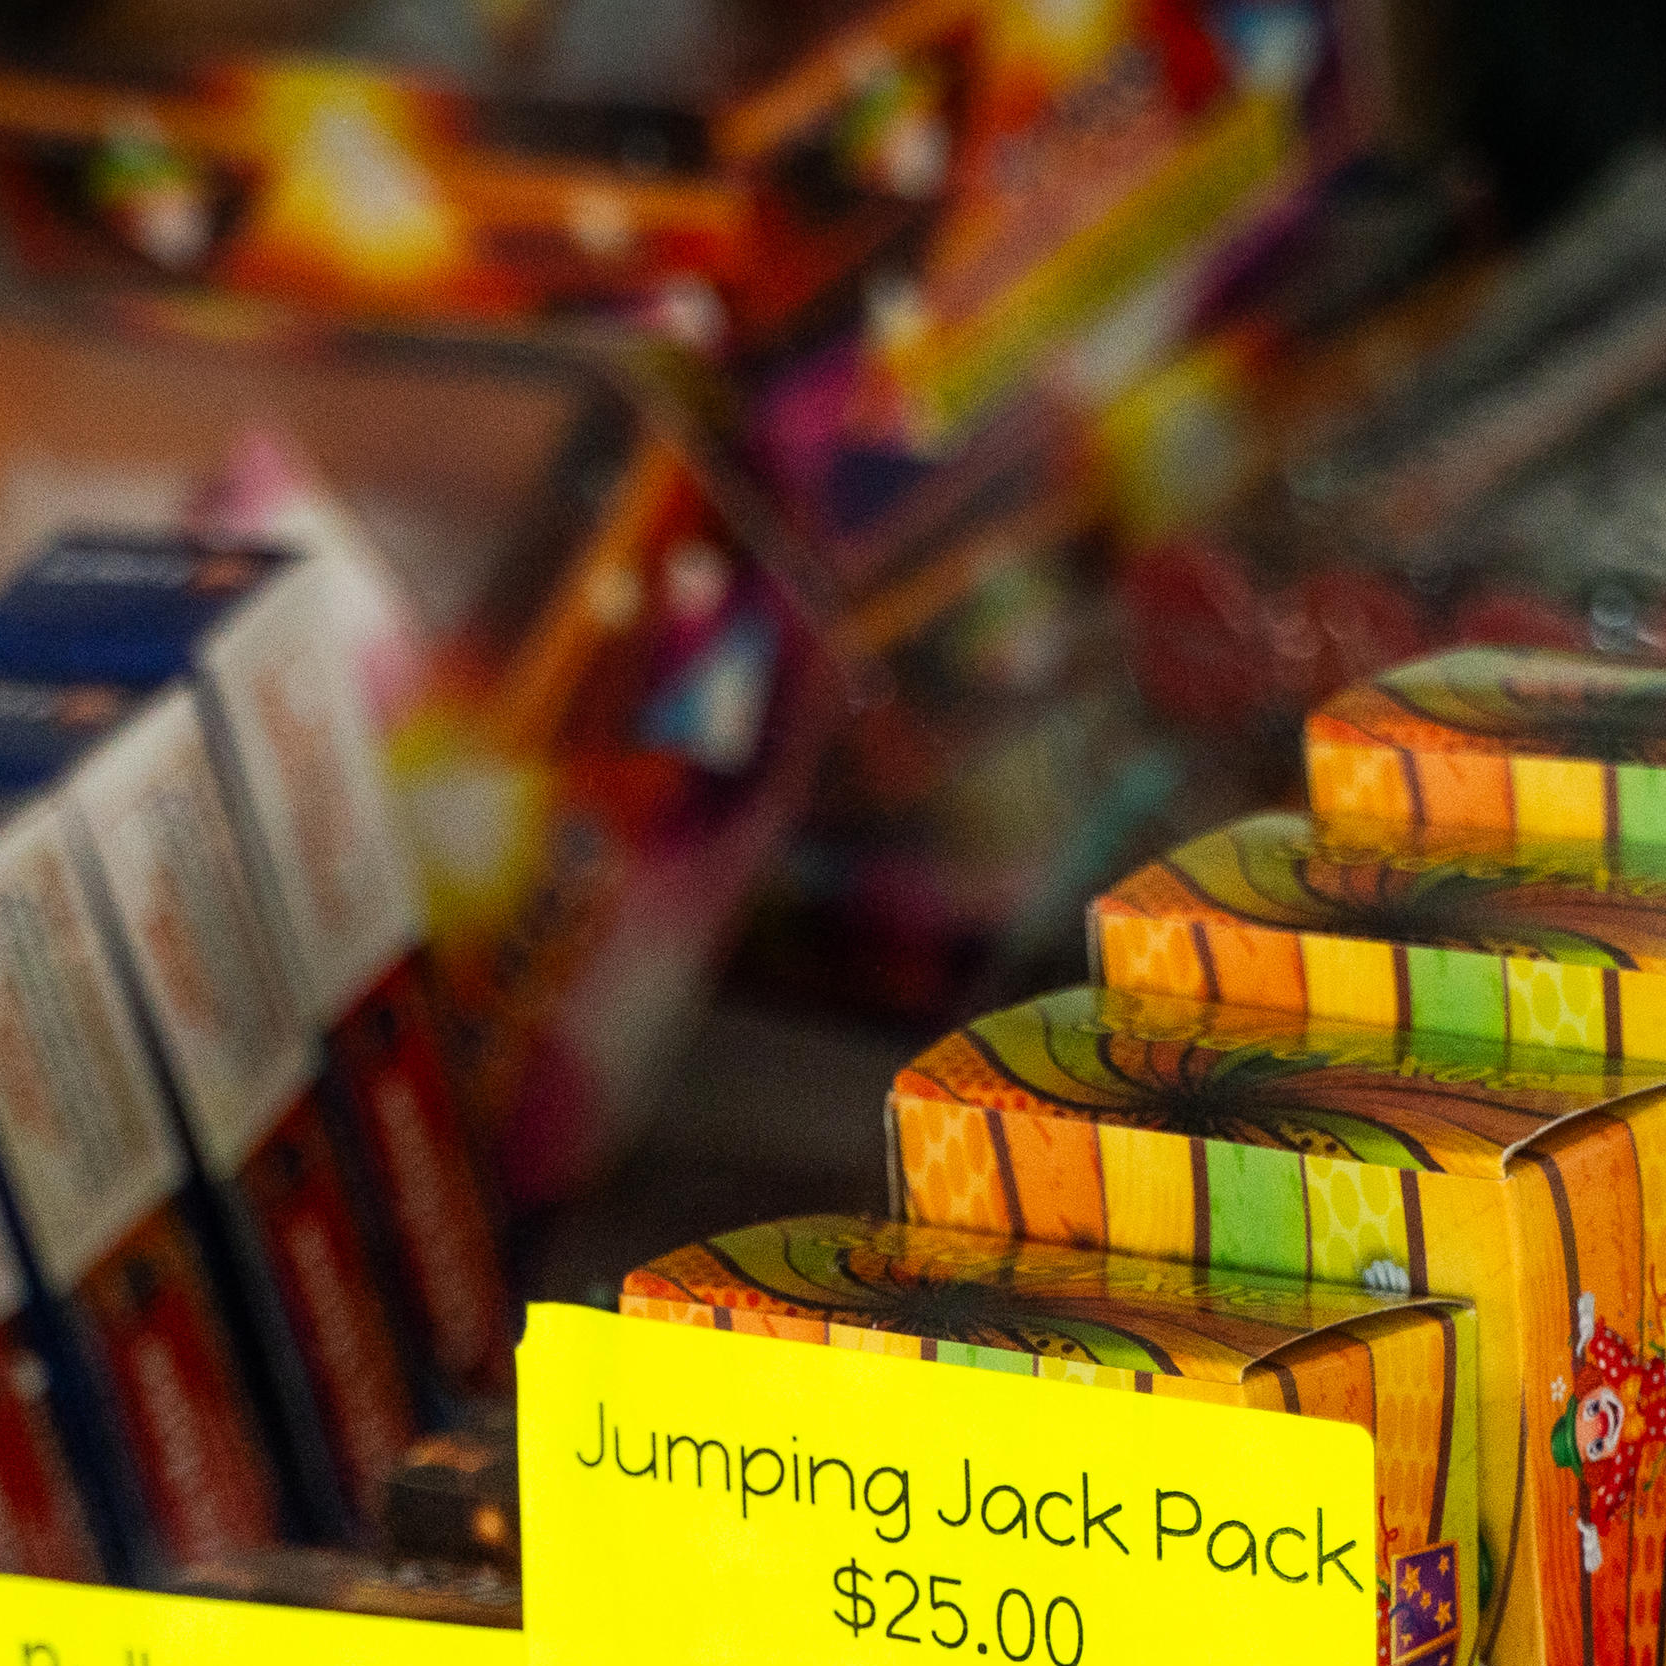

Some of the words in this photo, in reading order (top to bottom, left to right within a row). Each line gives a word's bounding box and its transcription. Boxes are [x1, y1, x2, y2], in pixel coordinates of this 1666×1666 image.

[576, 1401, 912, 1543] Jumping
[937, 1457, 1131, 1557] Jack
[1155, 1486, 1366, 1594] Pack
